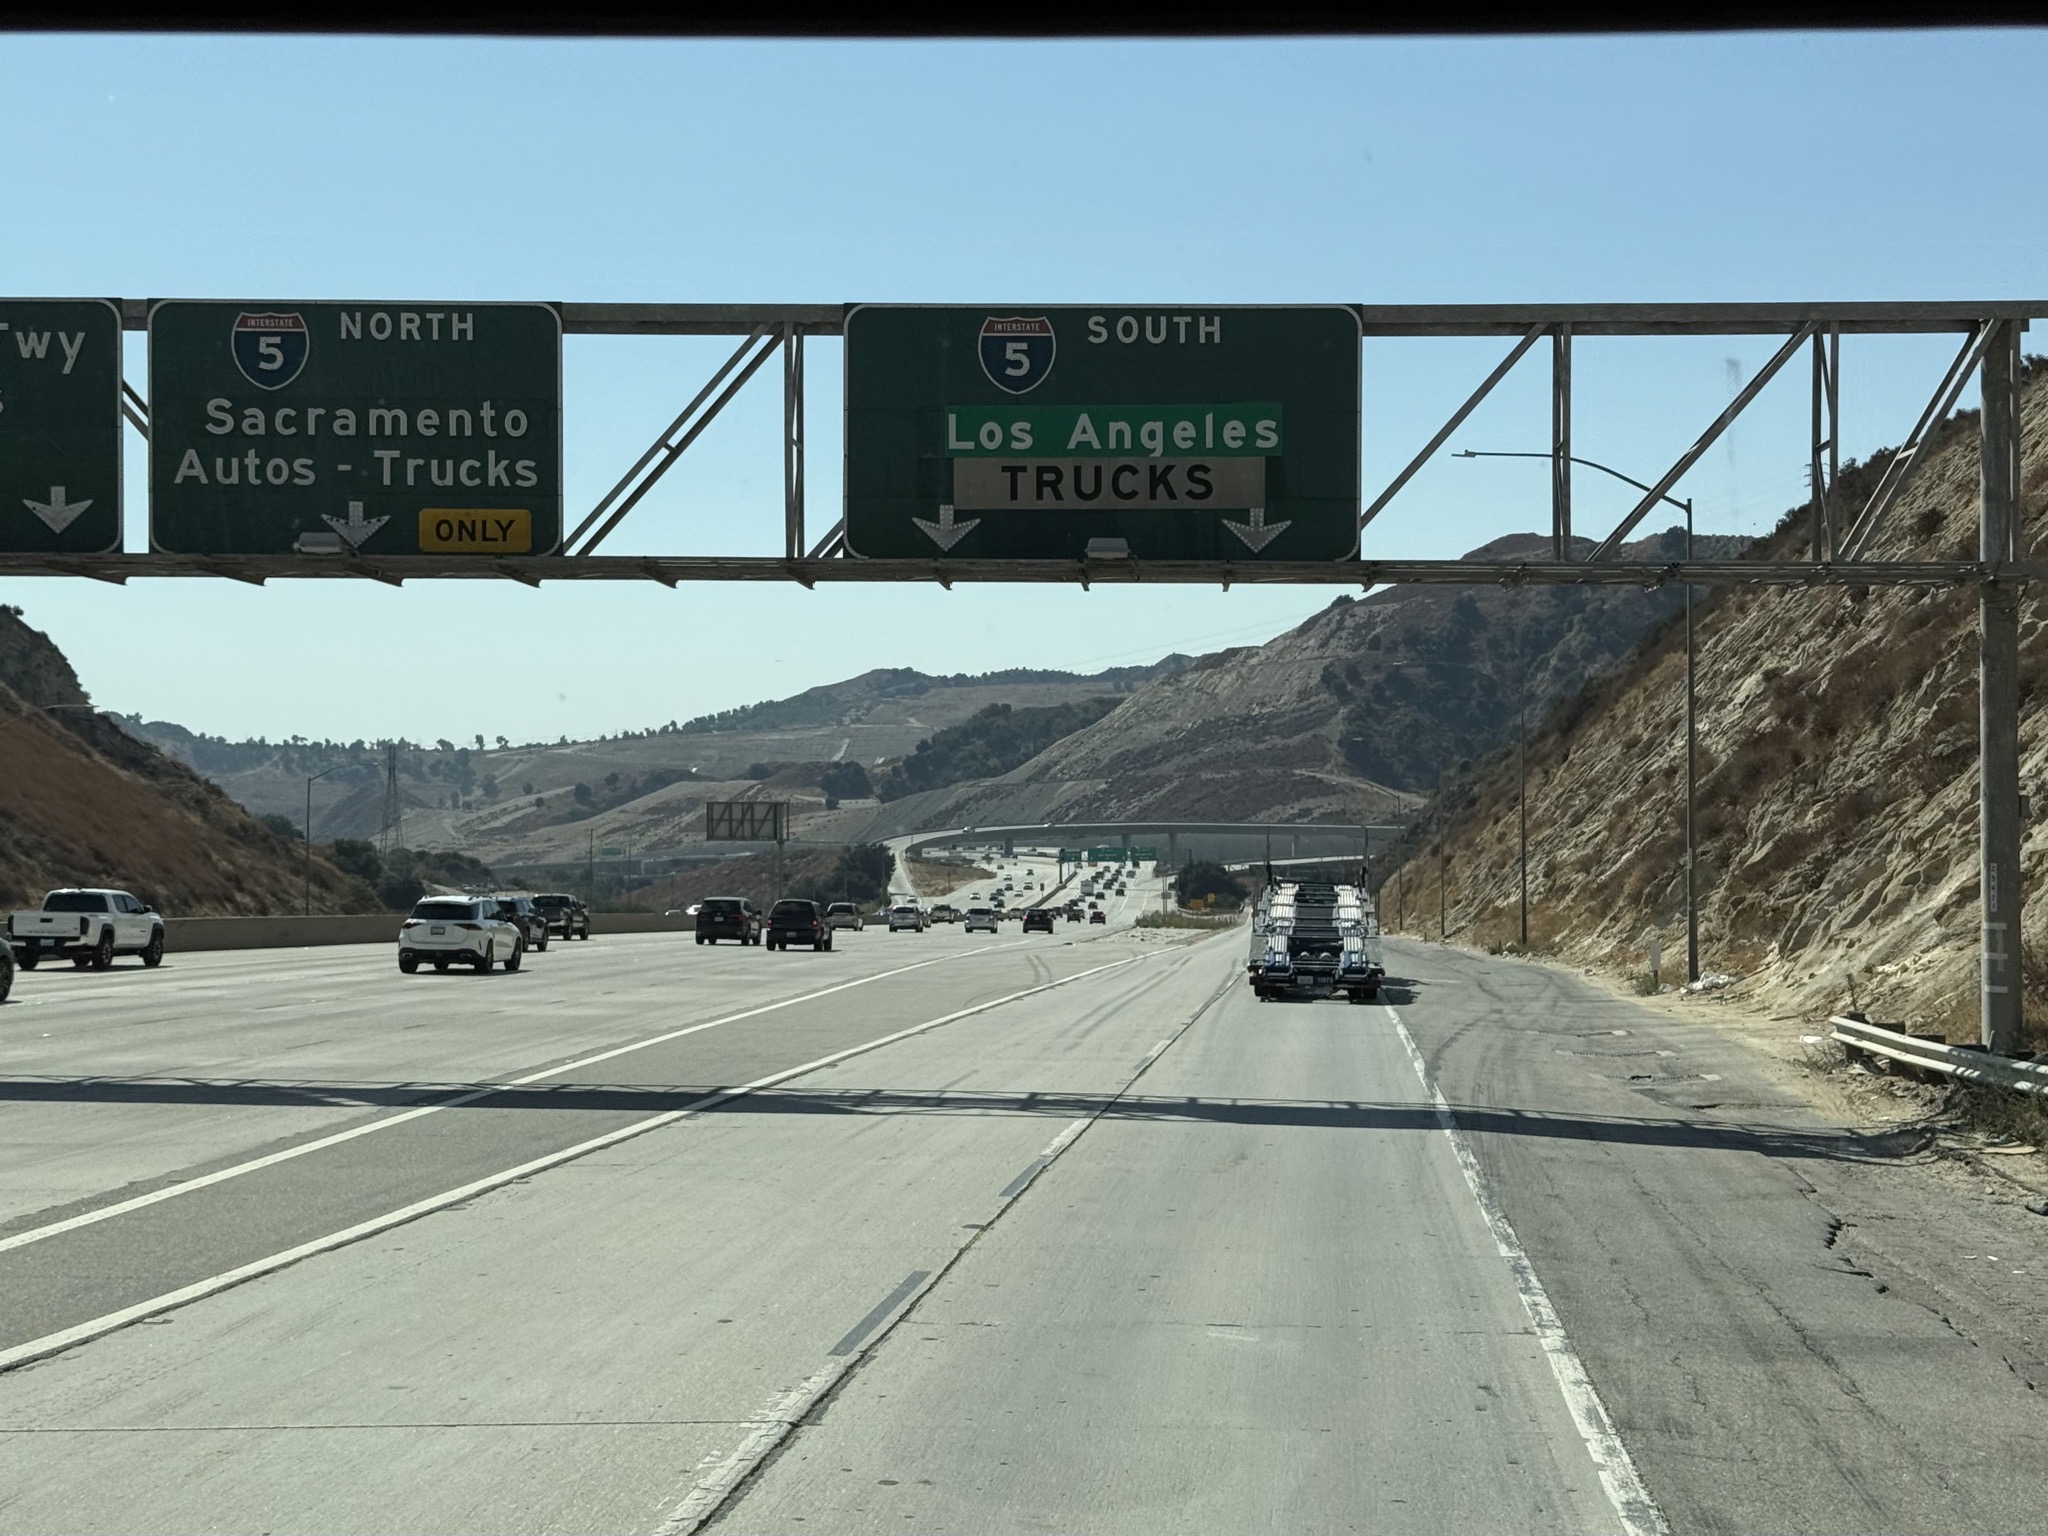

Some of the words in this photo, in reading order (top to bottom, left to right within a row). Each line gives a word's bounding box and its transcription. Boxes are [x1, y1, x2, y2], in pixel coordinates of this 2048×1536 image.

[247, 318, 294, 327] INTERSTATE
[340, 311, 474, 341] NORTH
[994, 322, 1041, 332] INTERSTATE
[1087, 315, 1221, 344] SOUTH
[0, 322, 86, 375] wy
[258, 336, 284, 371] 5
[1005, 342, 1030, 377] 5
[204, 397, 528, 437] Sacramento
[948, 413, 1034, 450] Los
[1066, 412, 1279, 458] Angeles
[173, 448, 316, 486] Autos
[373, 449, 538, 488] Trucks
[1000, 463, 1214, 502] TRUCKS
[435, 518, 516, 543] ONLY
